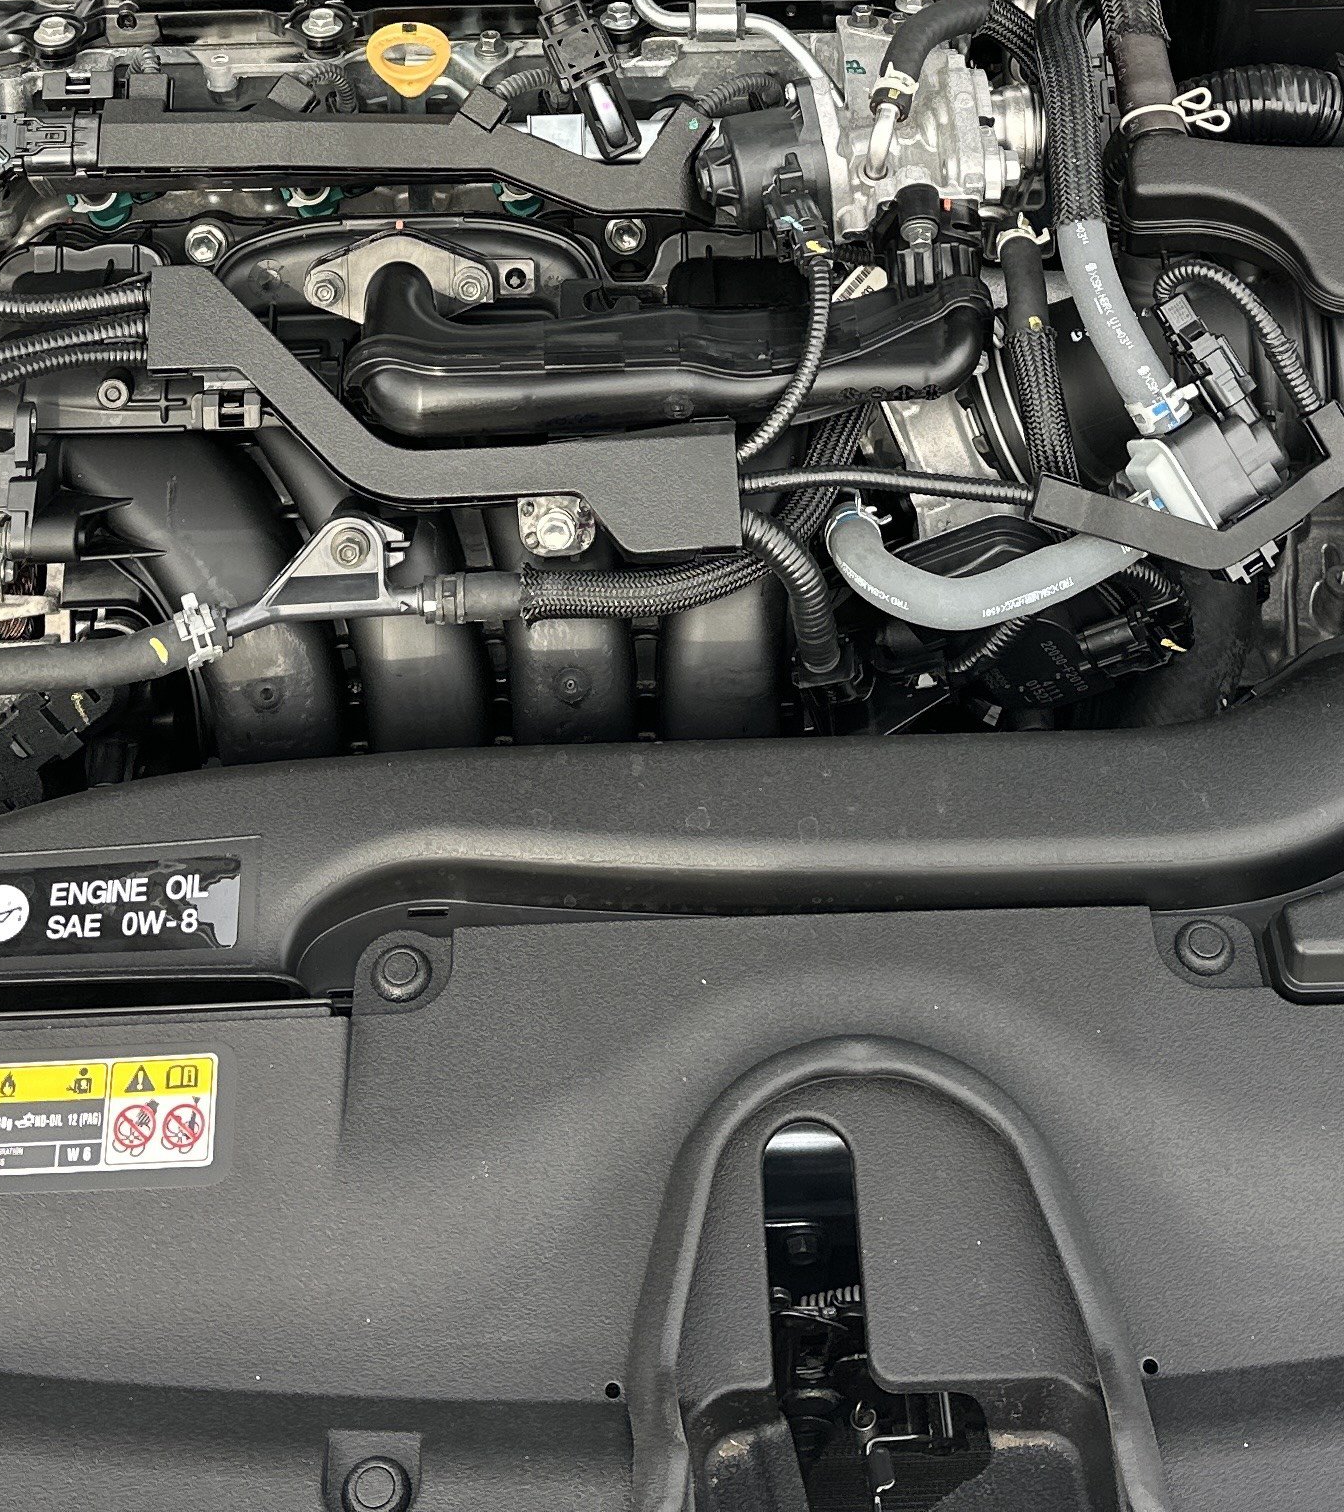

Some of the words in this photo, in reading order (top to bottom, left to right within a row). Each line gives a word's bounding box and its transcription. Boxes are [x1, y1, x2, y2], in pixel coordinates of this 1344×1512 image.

[1040, 640, 1089, 692] 22030-F2010
[50, 877, 149, 907] ENGINE
[165, 874, 209, 901] OIL
[45, 914, 102, 940] SAE
[121, 909, 199, 937] 0W-8
[34, 1113, 63, 1128] ND-OIL
[68, 1114, 78, 1126] 12
[79, 1112, 102, 1128] (PAG)
